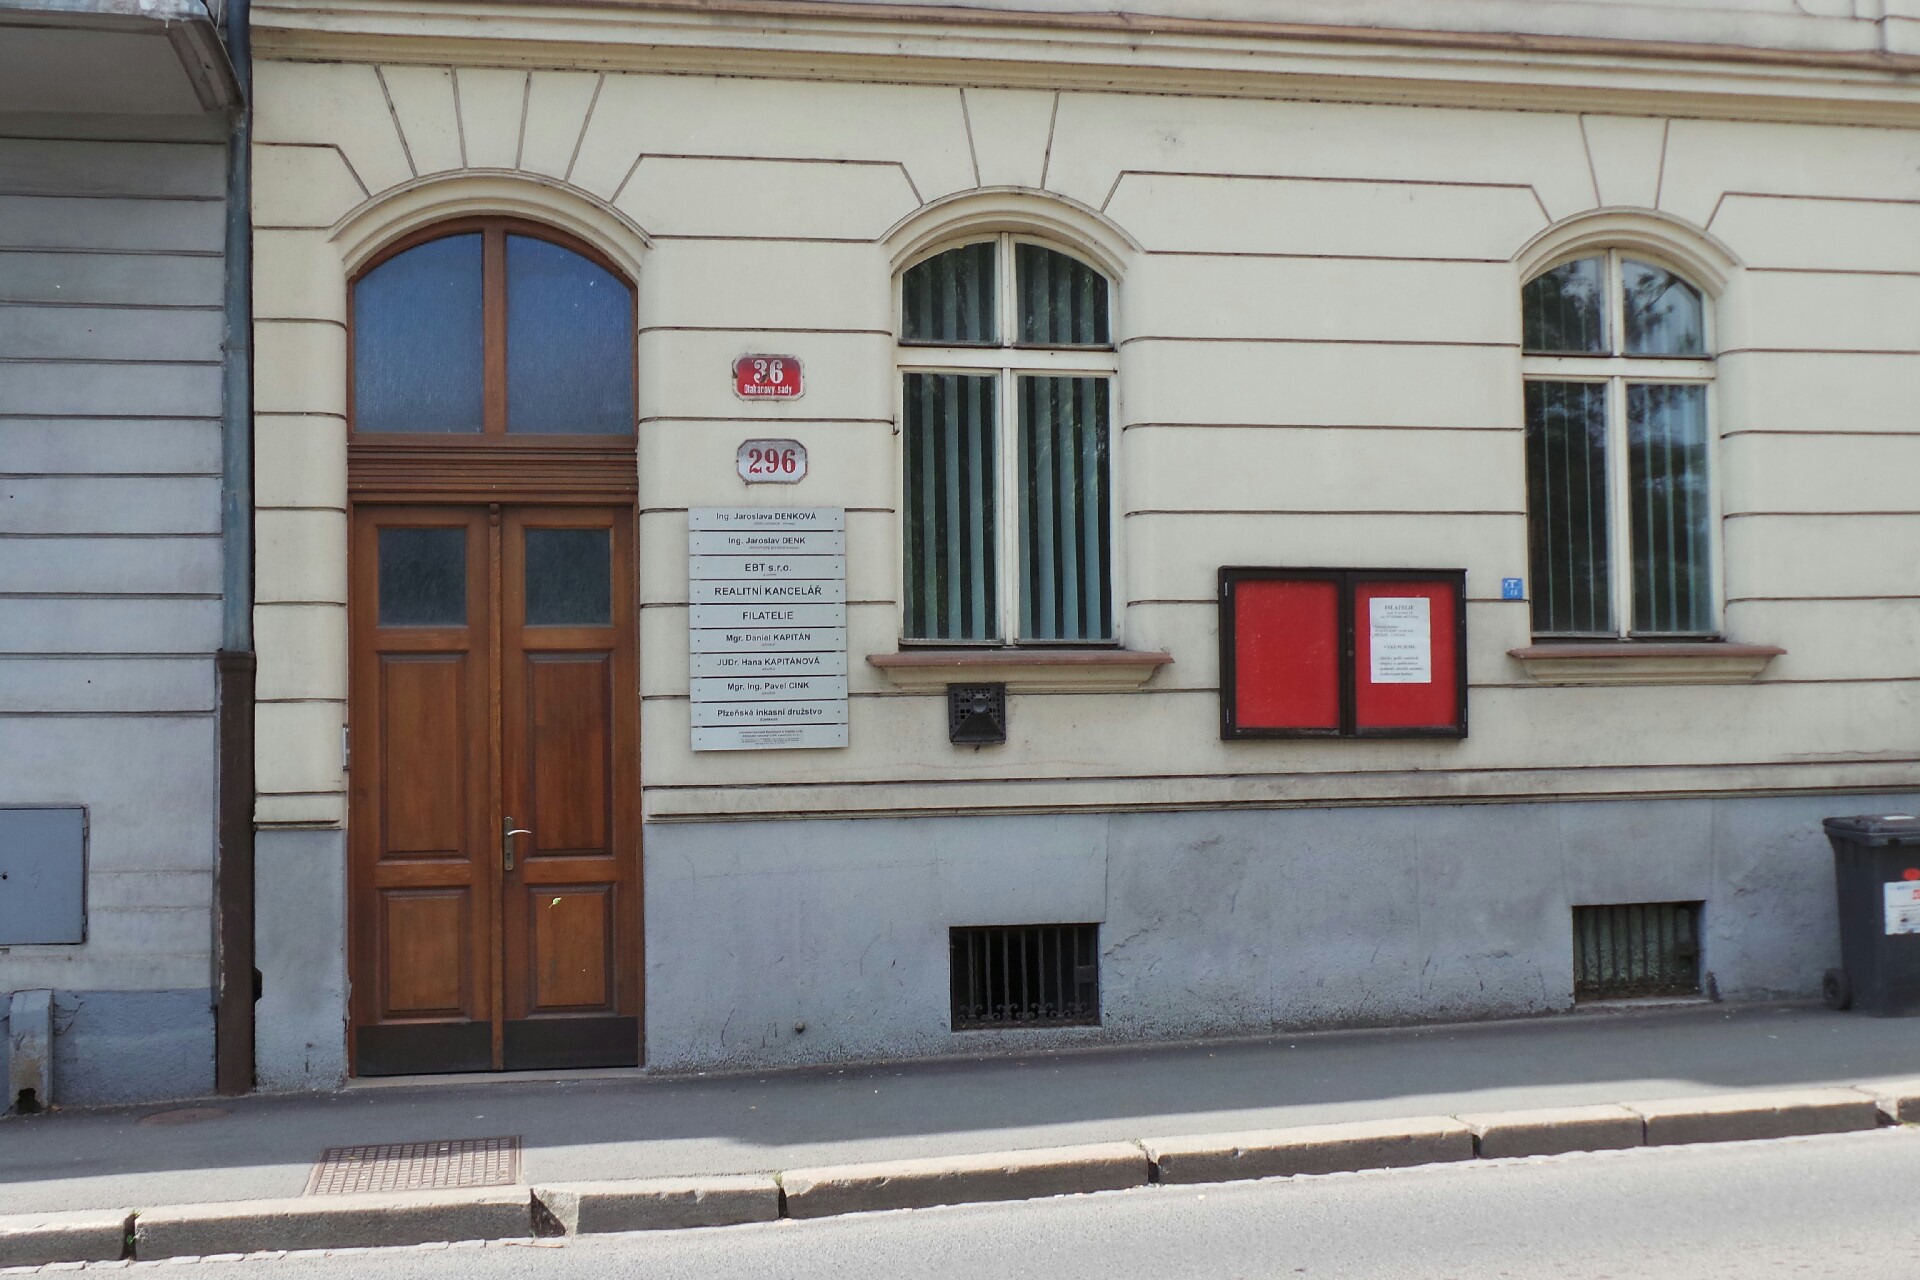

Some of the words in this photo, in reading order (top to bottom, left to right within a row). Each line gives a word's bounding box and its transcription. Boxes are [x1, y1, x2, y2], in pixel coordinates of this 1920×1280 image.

[753, 359, 784, 384] 36
[777, 384, 793, 396] sady
[748, 448, 796, 474] 296
[716, 512, 732, 521] Ing.
[733, 512, 773, 520] Jaroslava
[774, 511, 817, 520] DENKOVÁ
[728, 537, 743, 546] Ing.
[745, 537, 780, 545] Jaroslav
[782, 537, 806, 545] DENK
[744, 563, 766, 572] EBT
[768, 564, 792, 572] s.r.o.
[714, 585, 762, 596] REALITNÍ
[764, 584, 822, 596] KANCELÁŘ
[742, 611, 794, 620] FILATELIE
[725, 633, 743, 644] Mgr.
[745, 633, 771, 642] Daniel
[773, 632, 811, 641] KAPITÁN
[717, 658, 740, 667] JUDr.
[741, 658, 763, 666] Hana
[764, 656, 820, 666] KAPITÁNOVÁ
[727, 682, 745, 692] Mgr.
[747, 682, 762, 692] Ing.
[764, 682, 787, 690] Pavel
[788, 681, 810, 690] CINK
[717, 708, 754, 718] Plzeňské
[755, 707, 785, 717] inkasní
[787, 707, 823, 716] družstvo
